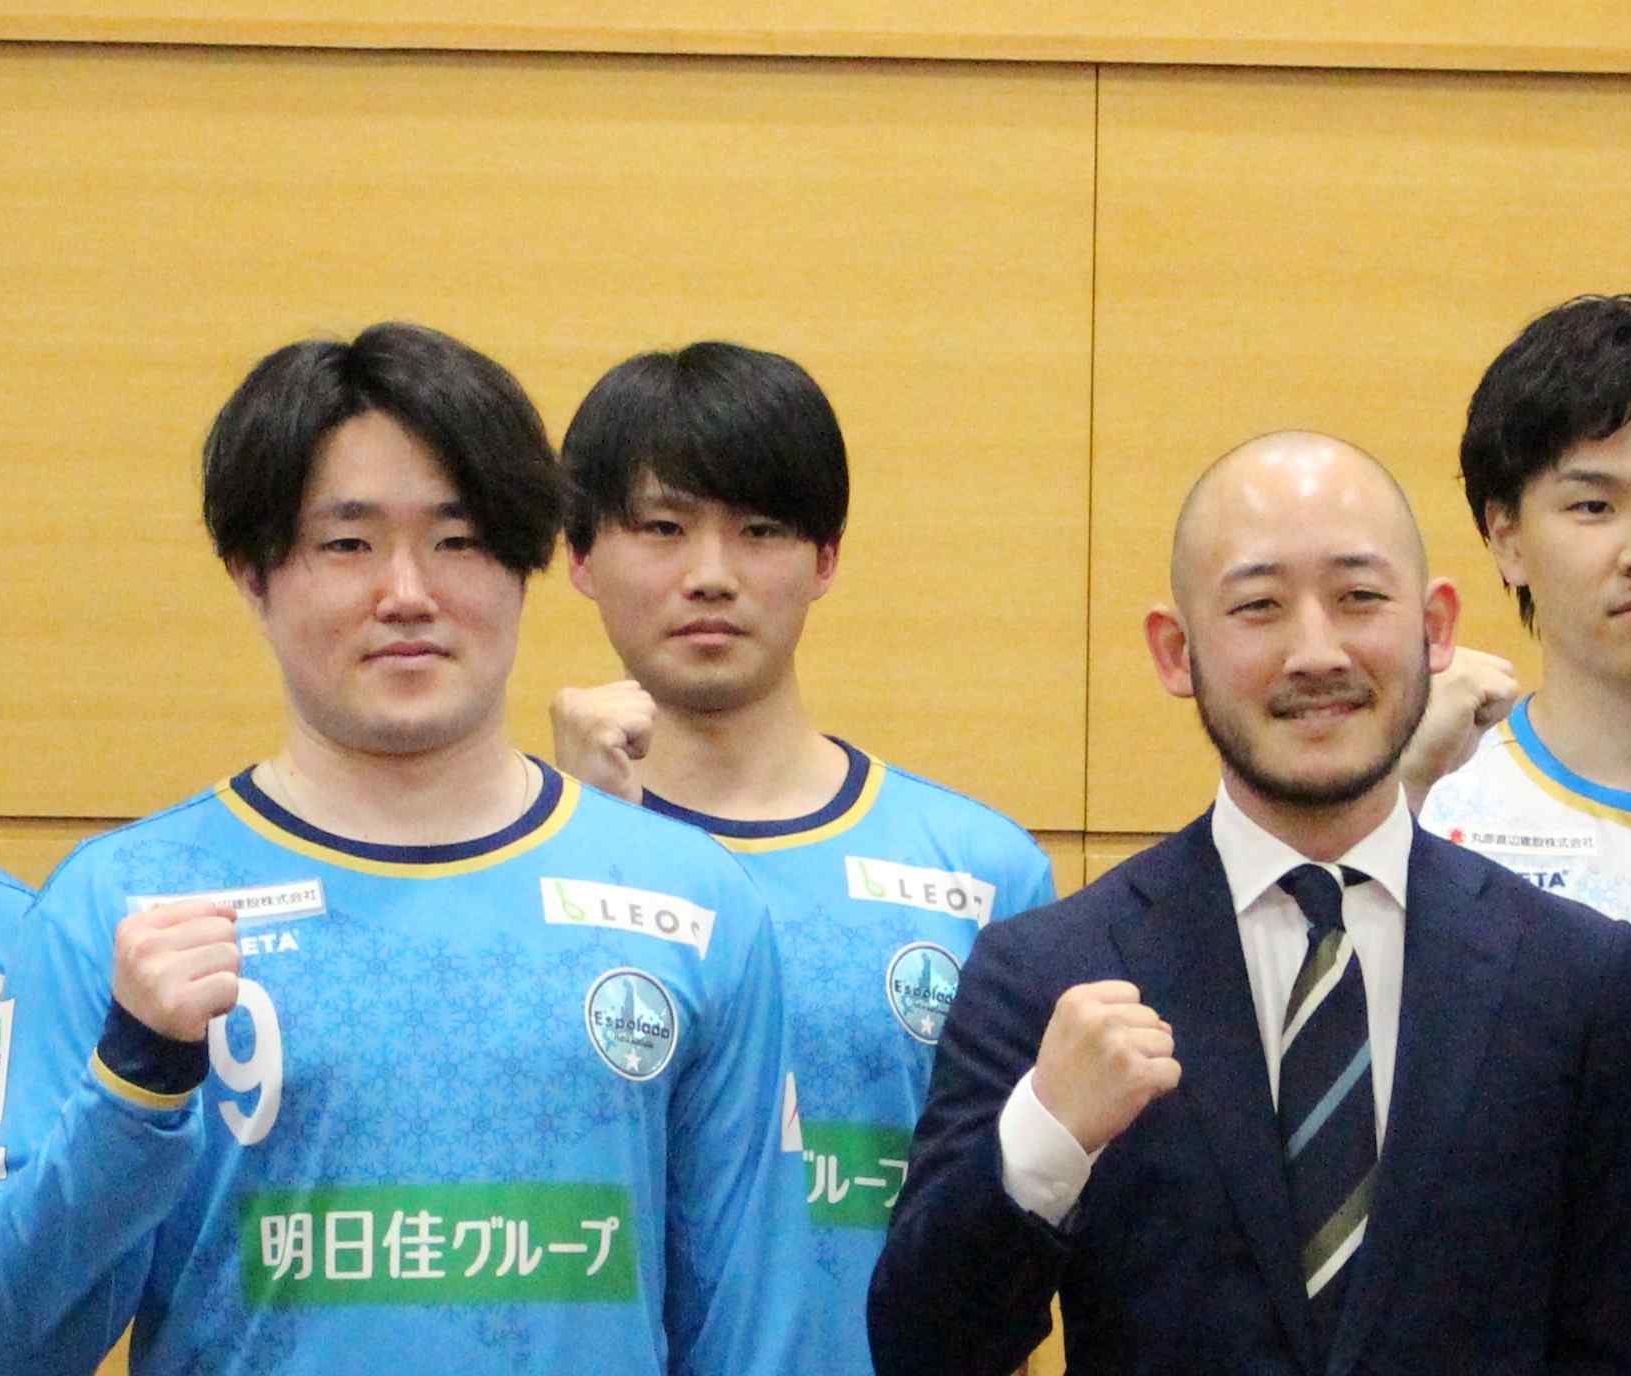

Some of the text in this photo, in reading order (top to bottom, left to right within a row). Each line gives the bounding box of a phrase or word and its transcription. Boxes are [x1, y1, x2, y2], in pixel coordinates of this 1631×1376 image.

[208, 978, 284, 1146] 9
[261, 1208, 620, 1281] 明日佳グループ
